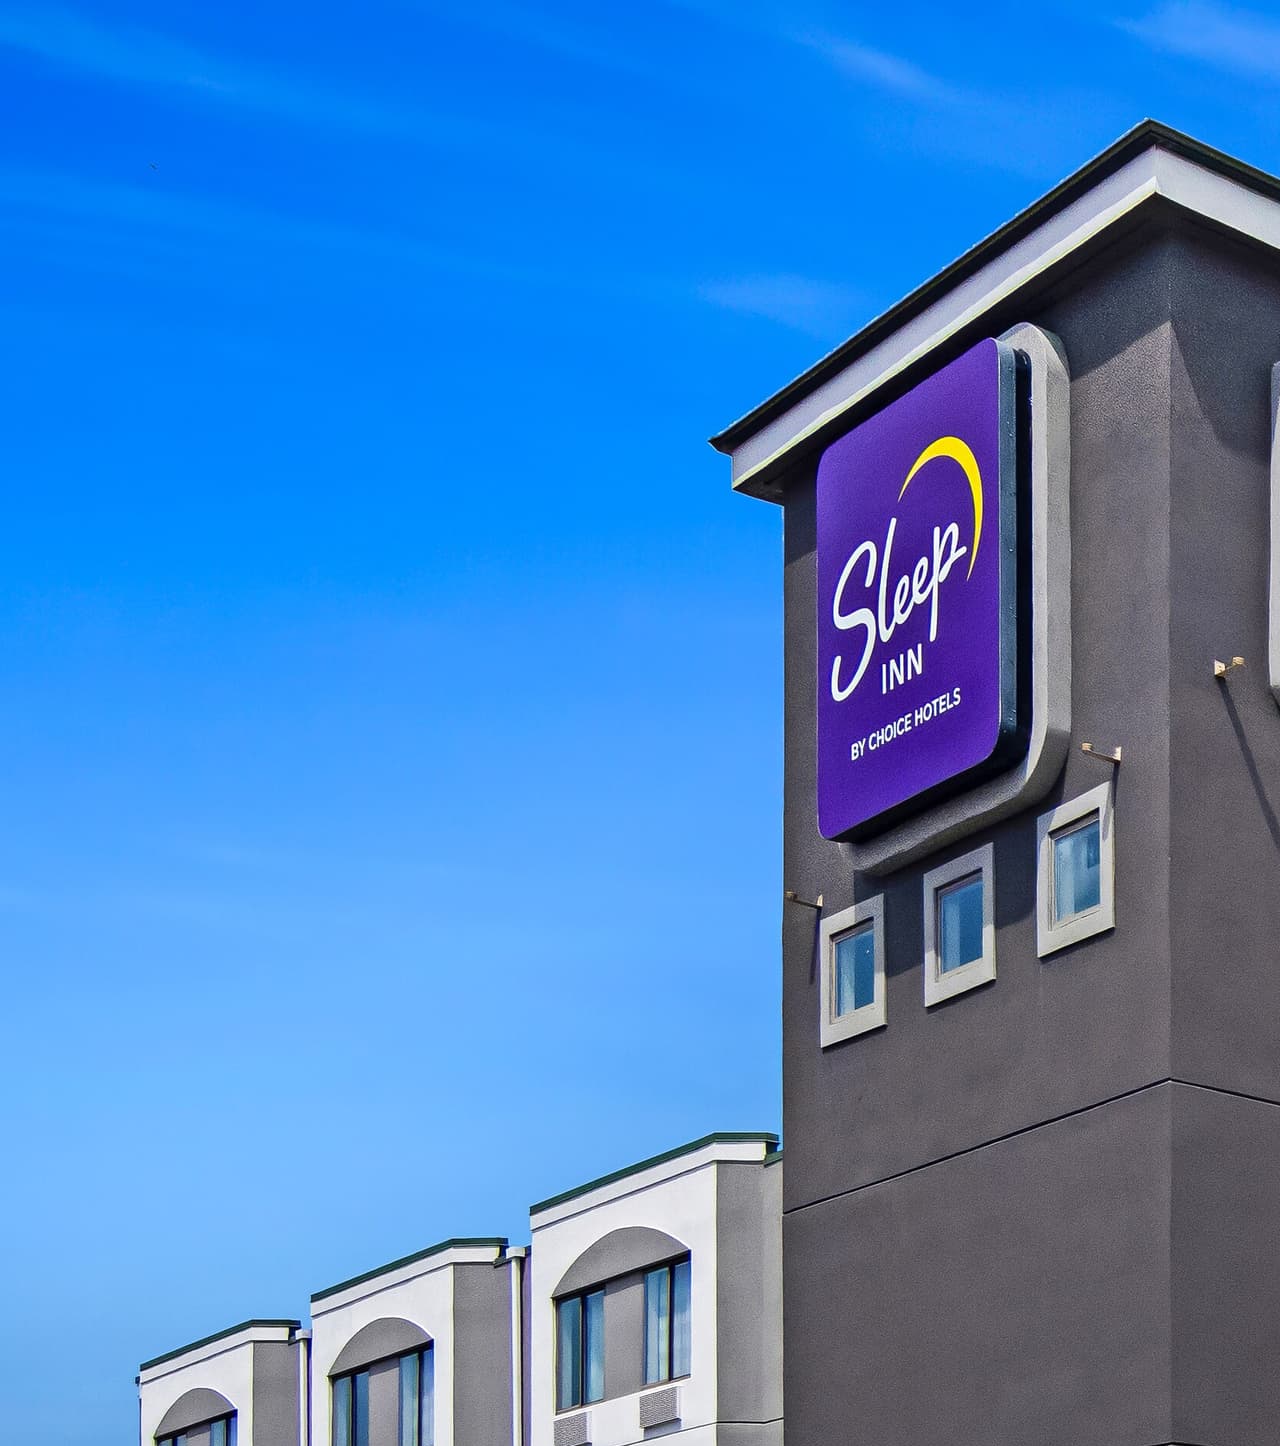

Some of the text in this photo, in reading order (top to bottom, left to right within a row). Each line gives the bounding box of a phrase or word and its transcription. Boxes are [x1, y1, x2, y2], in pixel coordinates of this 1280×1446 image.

[830, 516, 968, 702] Sleep
[880, 643, 923, 695] INN
[850, 686, 961, 761] BY CHOICE HOTELS
